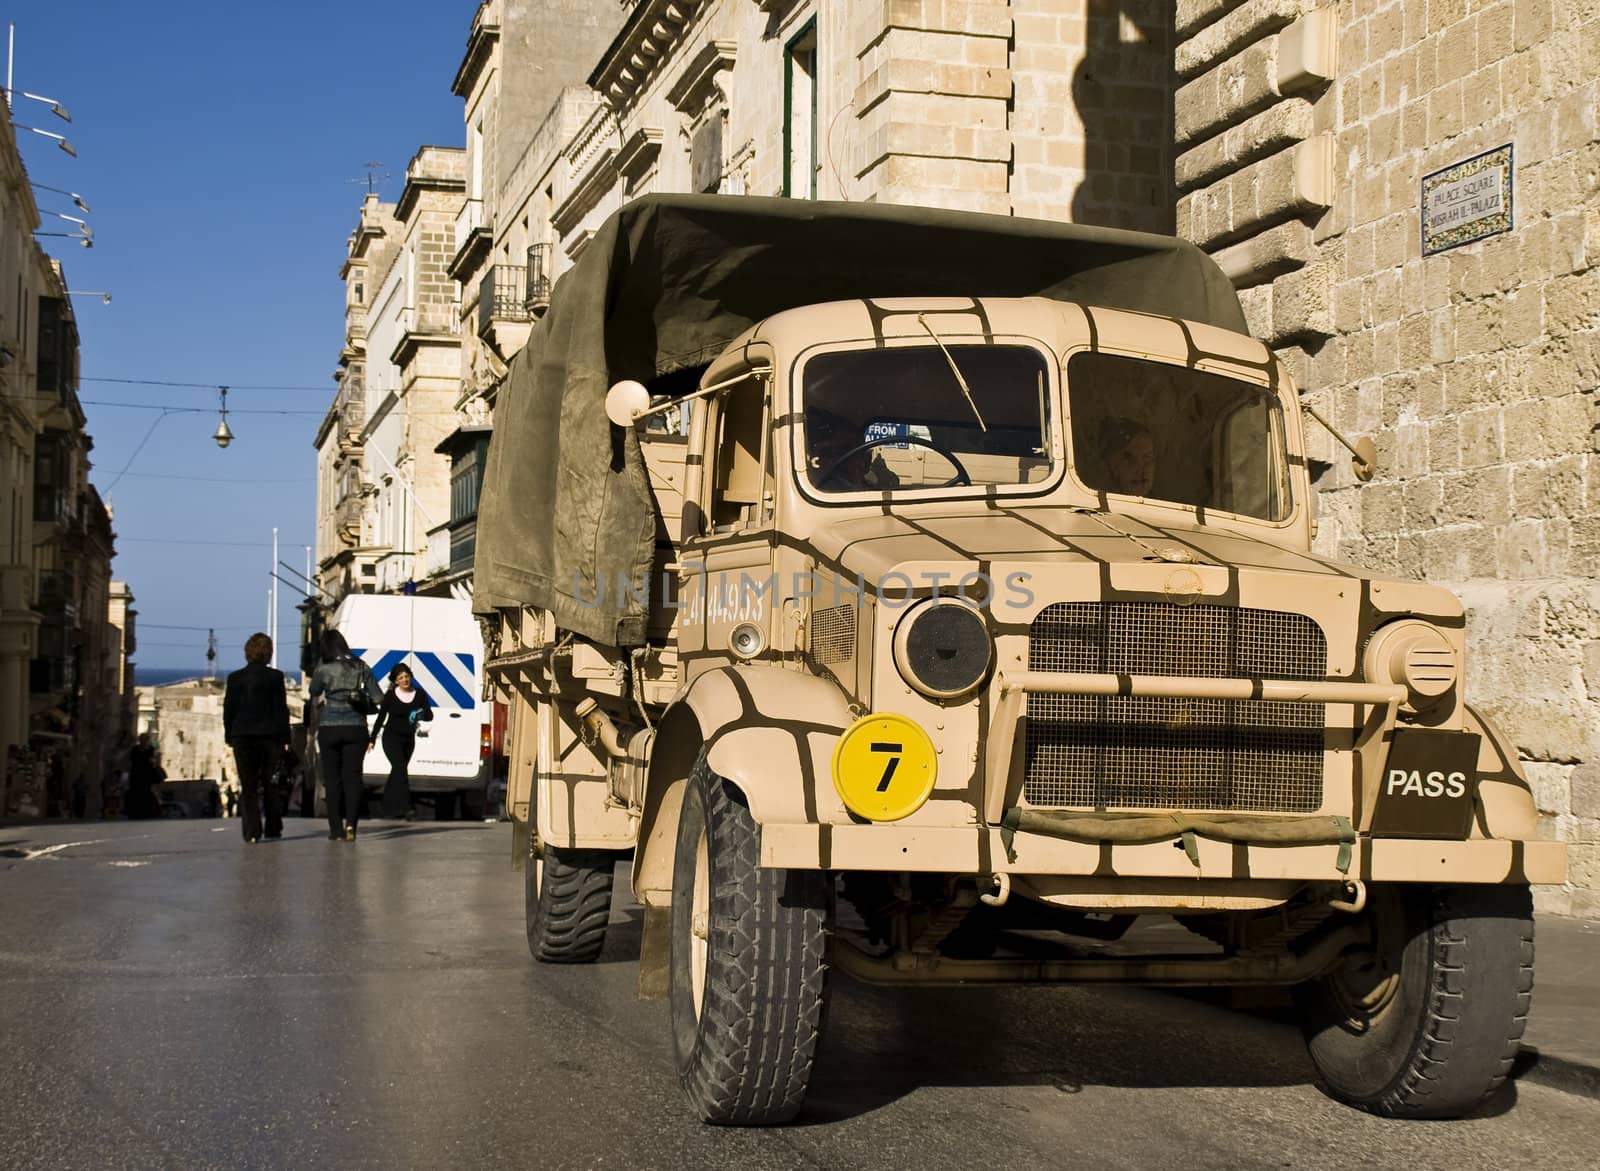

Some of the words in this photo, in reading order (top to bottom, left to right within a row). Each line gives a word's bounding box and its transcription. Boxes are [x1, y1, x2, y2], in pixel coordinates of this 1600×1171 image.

[1434, 187, 1460, 206] PALACE
[1463, 176, 1495, 195] SQUARE
[868, 425, 897, 436] FROM
[871, 743, 902, 792] 7
[1387, 770, 1466, 798] PASS
